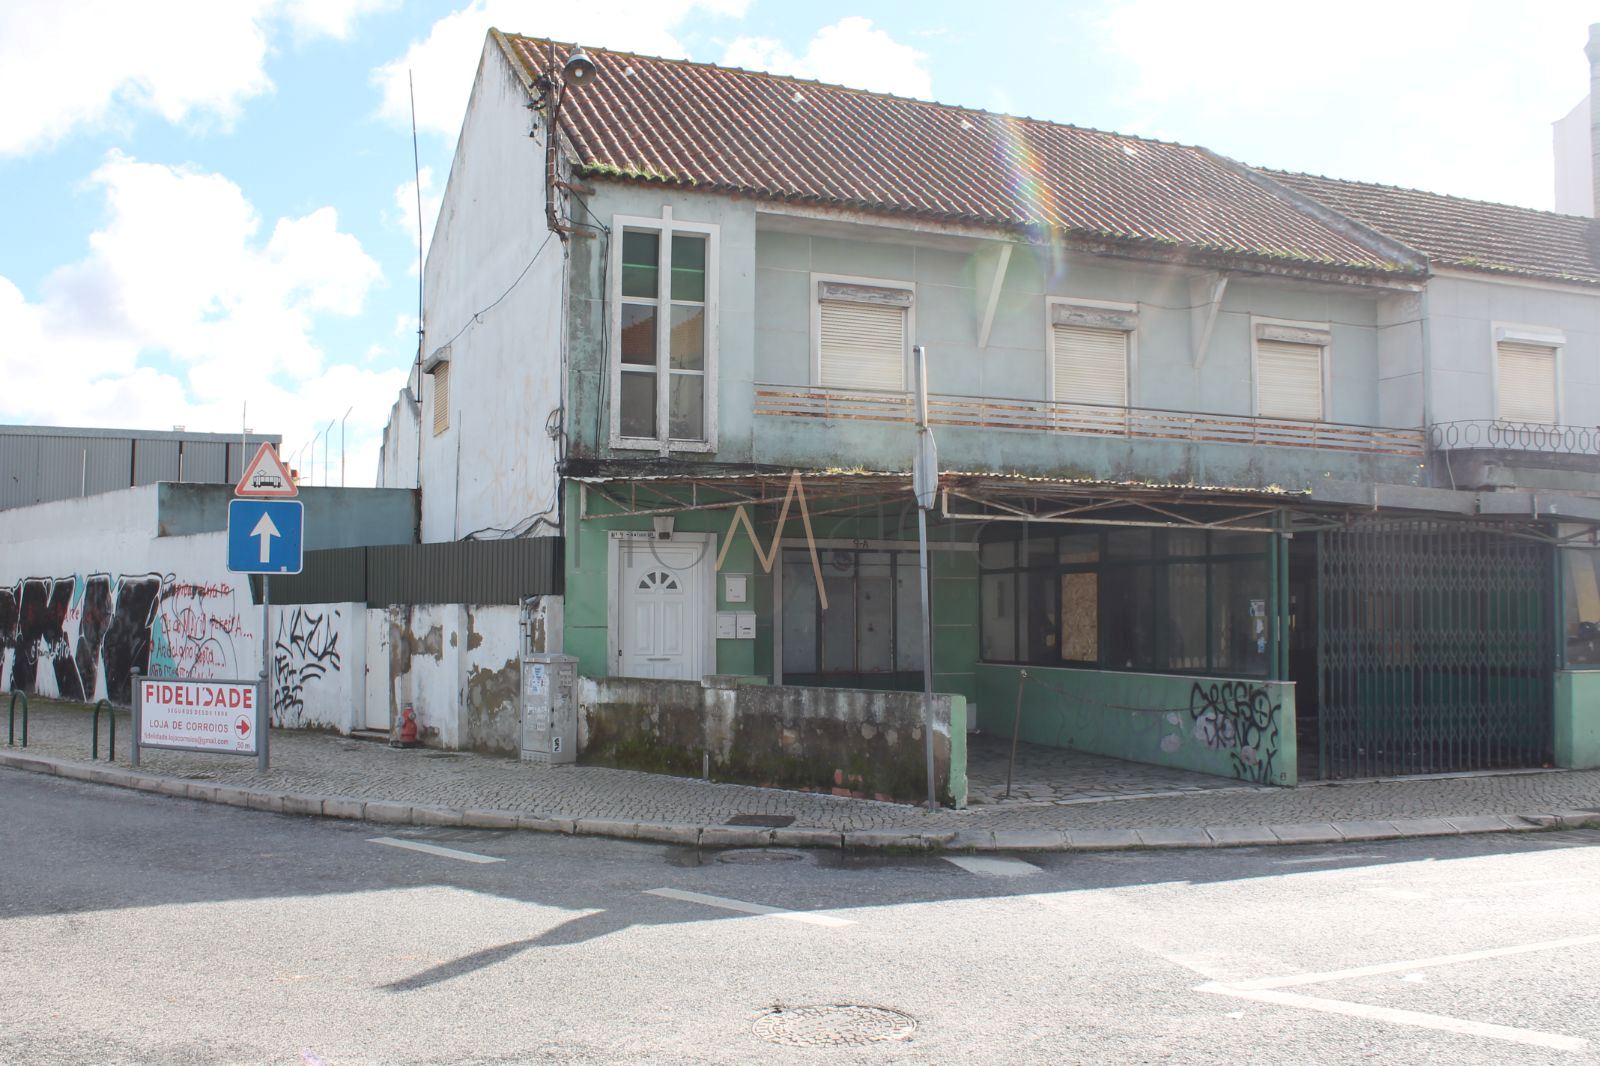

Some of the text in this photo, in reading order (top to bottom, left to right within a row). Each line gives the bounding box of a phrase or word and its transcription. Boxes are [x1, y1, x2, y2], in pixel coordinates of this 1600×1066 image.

[146, 684, 252, 708] FIDELIDADE
[149, 719, 229, 734] LOJA DE CORROIOS
[236, 741, 244, 750] 50
